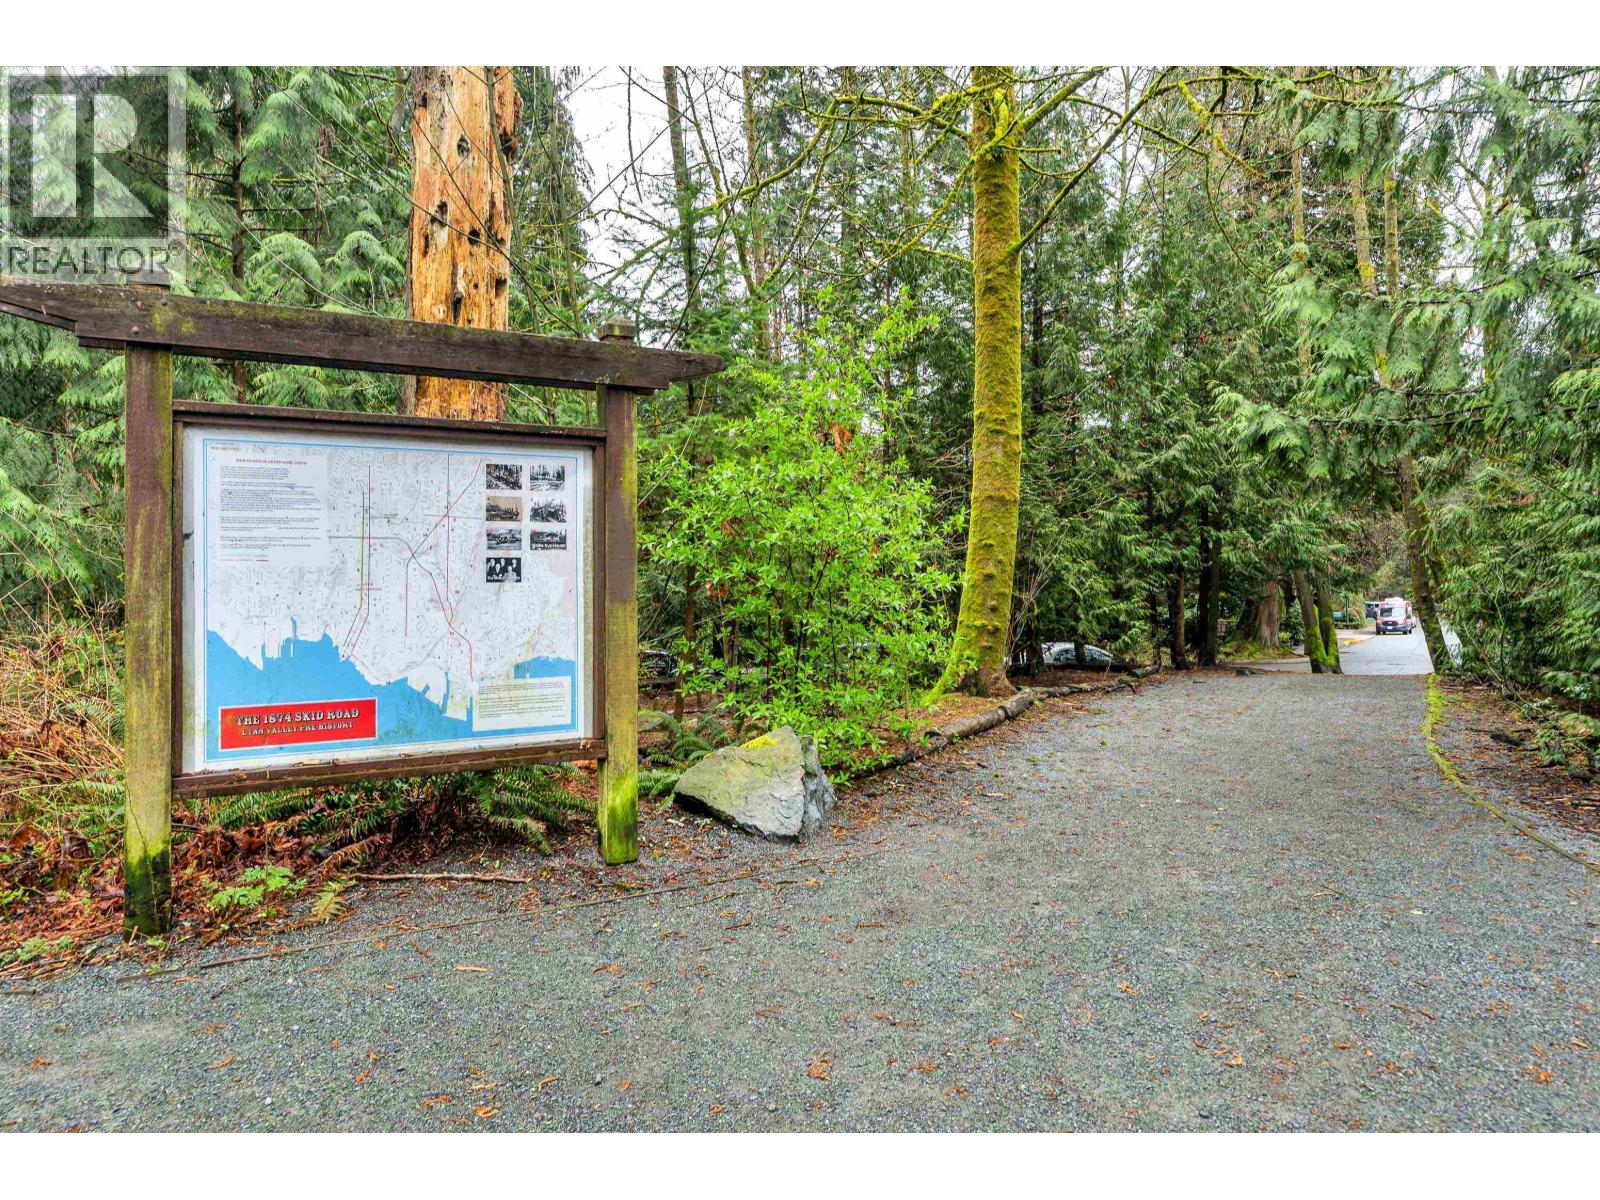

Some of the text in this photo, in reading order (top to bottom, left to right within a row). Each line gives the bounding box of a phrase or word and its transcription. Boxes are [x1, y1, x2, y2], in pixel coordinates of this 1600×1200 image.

[236, 708, 360, 725] THE 1874 SKID ROAD
[267, 725, 297, 734] VALLEY
